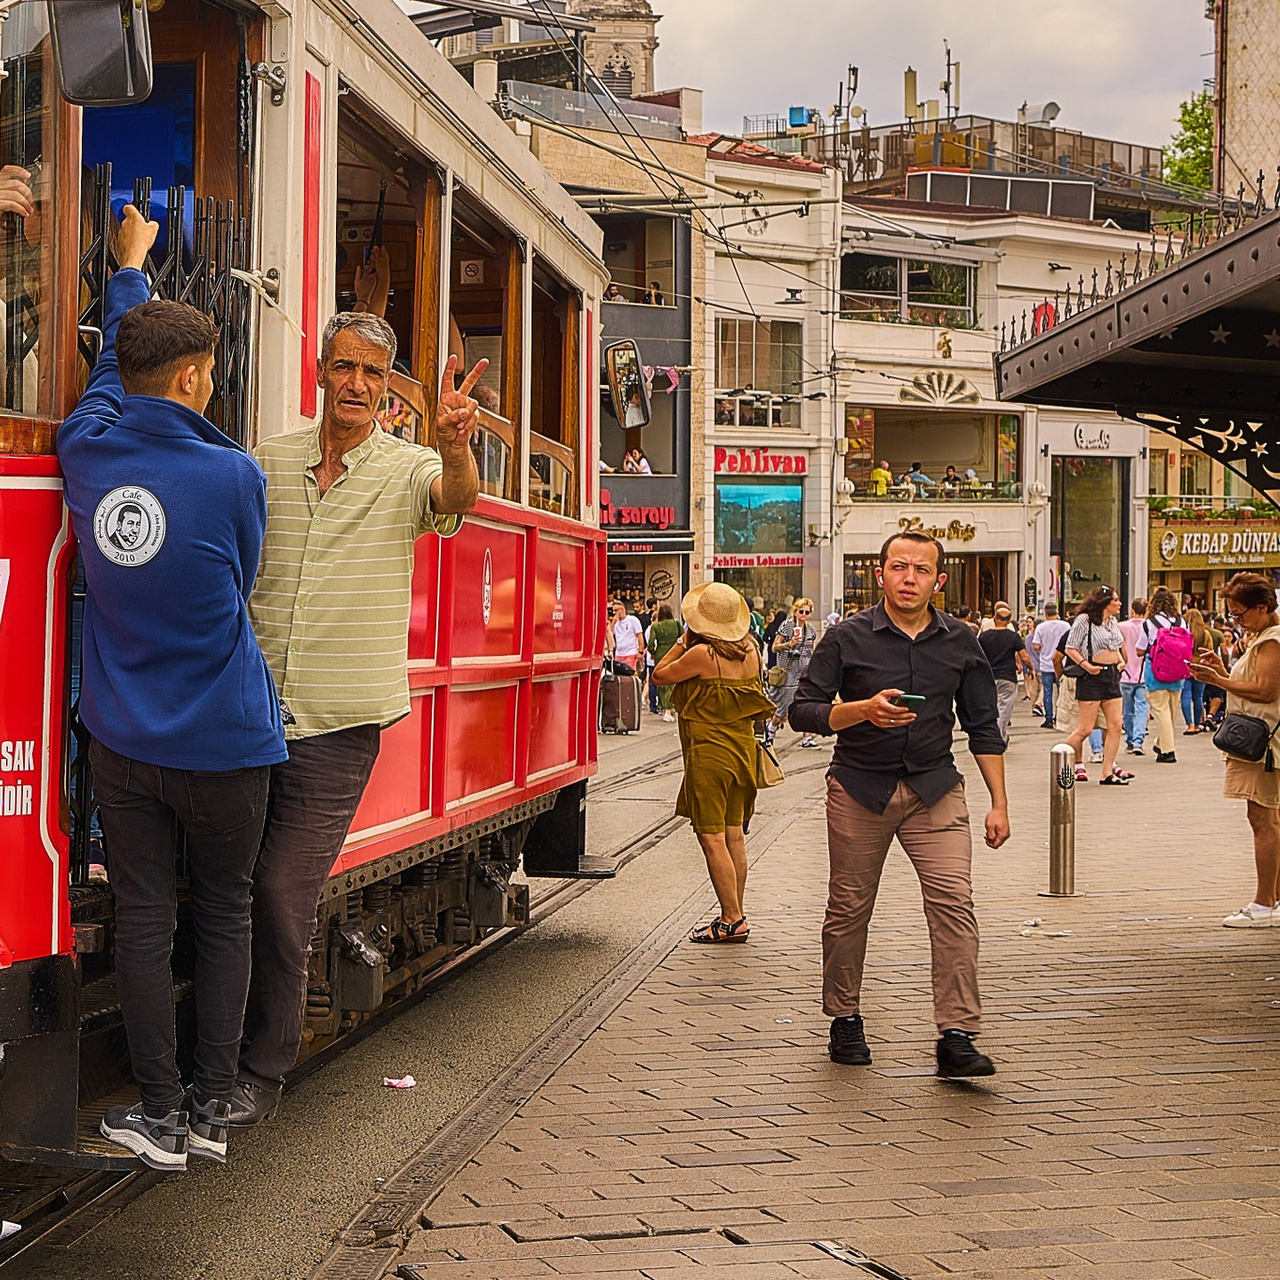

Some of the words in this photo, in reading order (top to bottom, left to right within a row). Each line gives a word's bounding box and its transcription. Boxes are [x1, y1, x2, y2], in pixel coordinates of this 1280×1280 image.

[714, 447, 806, 473] Pehlivan
[122, 489, 142, 501] Cafe
[612, 542, 630, 552] simit
[1181, 532, 1229, 555] KEBAP
[114, 551, 136, 563] 2010
[713, 556, 755, 567] Pehlivan
